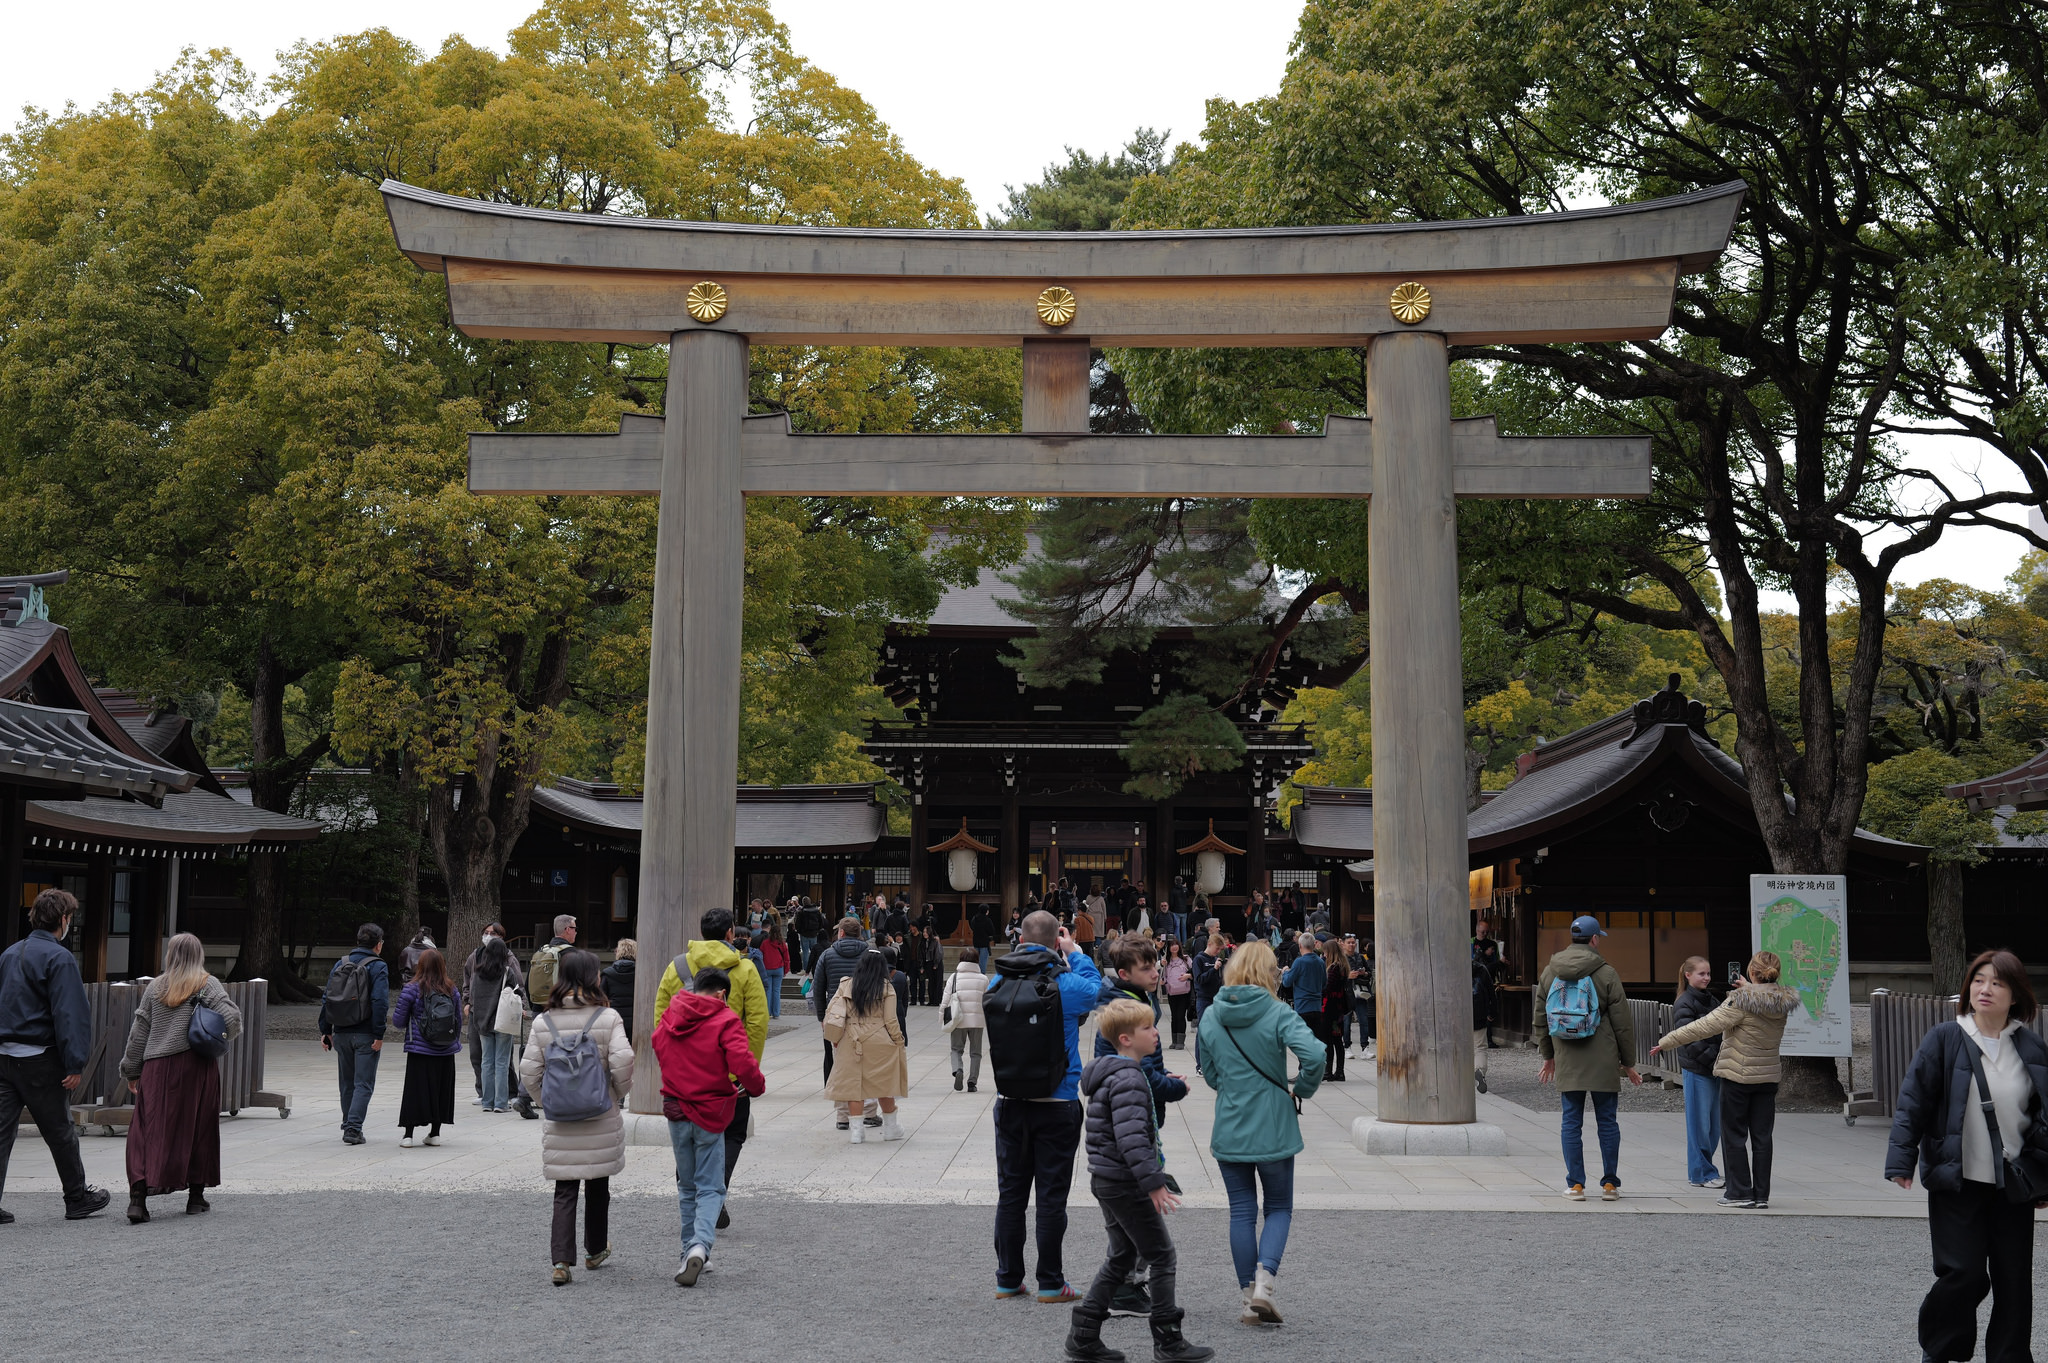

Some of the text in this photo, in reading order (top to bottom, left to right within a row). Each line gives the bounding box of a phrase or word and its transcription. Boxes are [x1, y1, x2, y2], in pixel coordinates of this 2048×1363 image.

[1766, 880, 1836, 891] 明治神宮境内図
